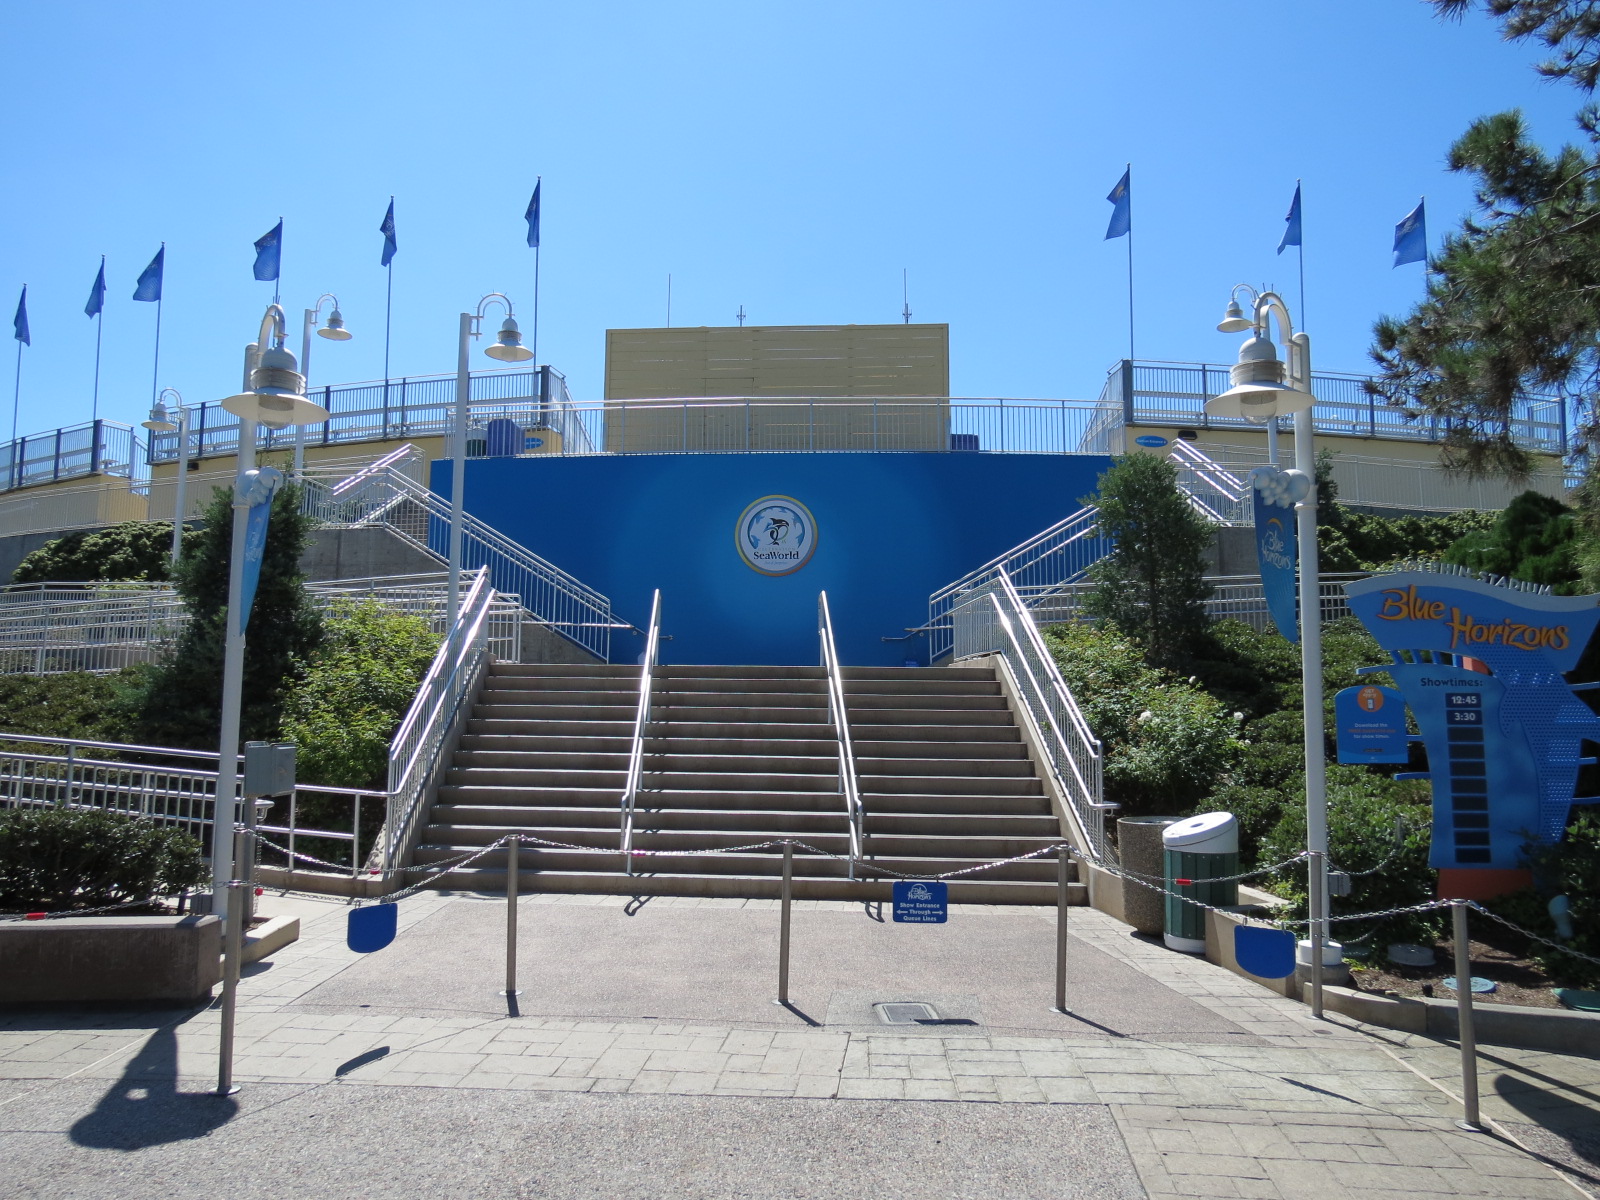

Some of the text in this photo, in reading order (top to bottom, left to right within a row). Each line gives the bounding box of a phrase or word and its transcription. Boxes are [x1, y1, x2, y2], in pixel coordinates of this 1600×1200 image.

[753, 551, 799, 560] SeaWorld
[1477, 571, 1552, 596] STADIUM
[1376, 584, 1445, 621] Blue
[1445, 607, 1570, 651] Horizons
[1420, 678, 1483, 687] Showtimes:
[1451, 695, 1477, 704] 12:45
[1454, 712, 1476, 721] 3:30
